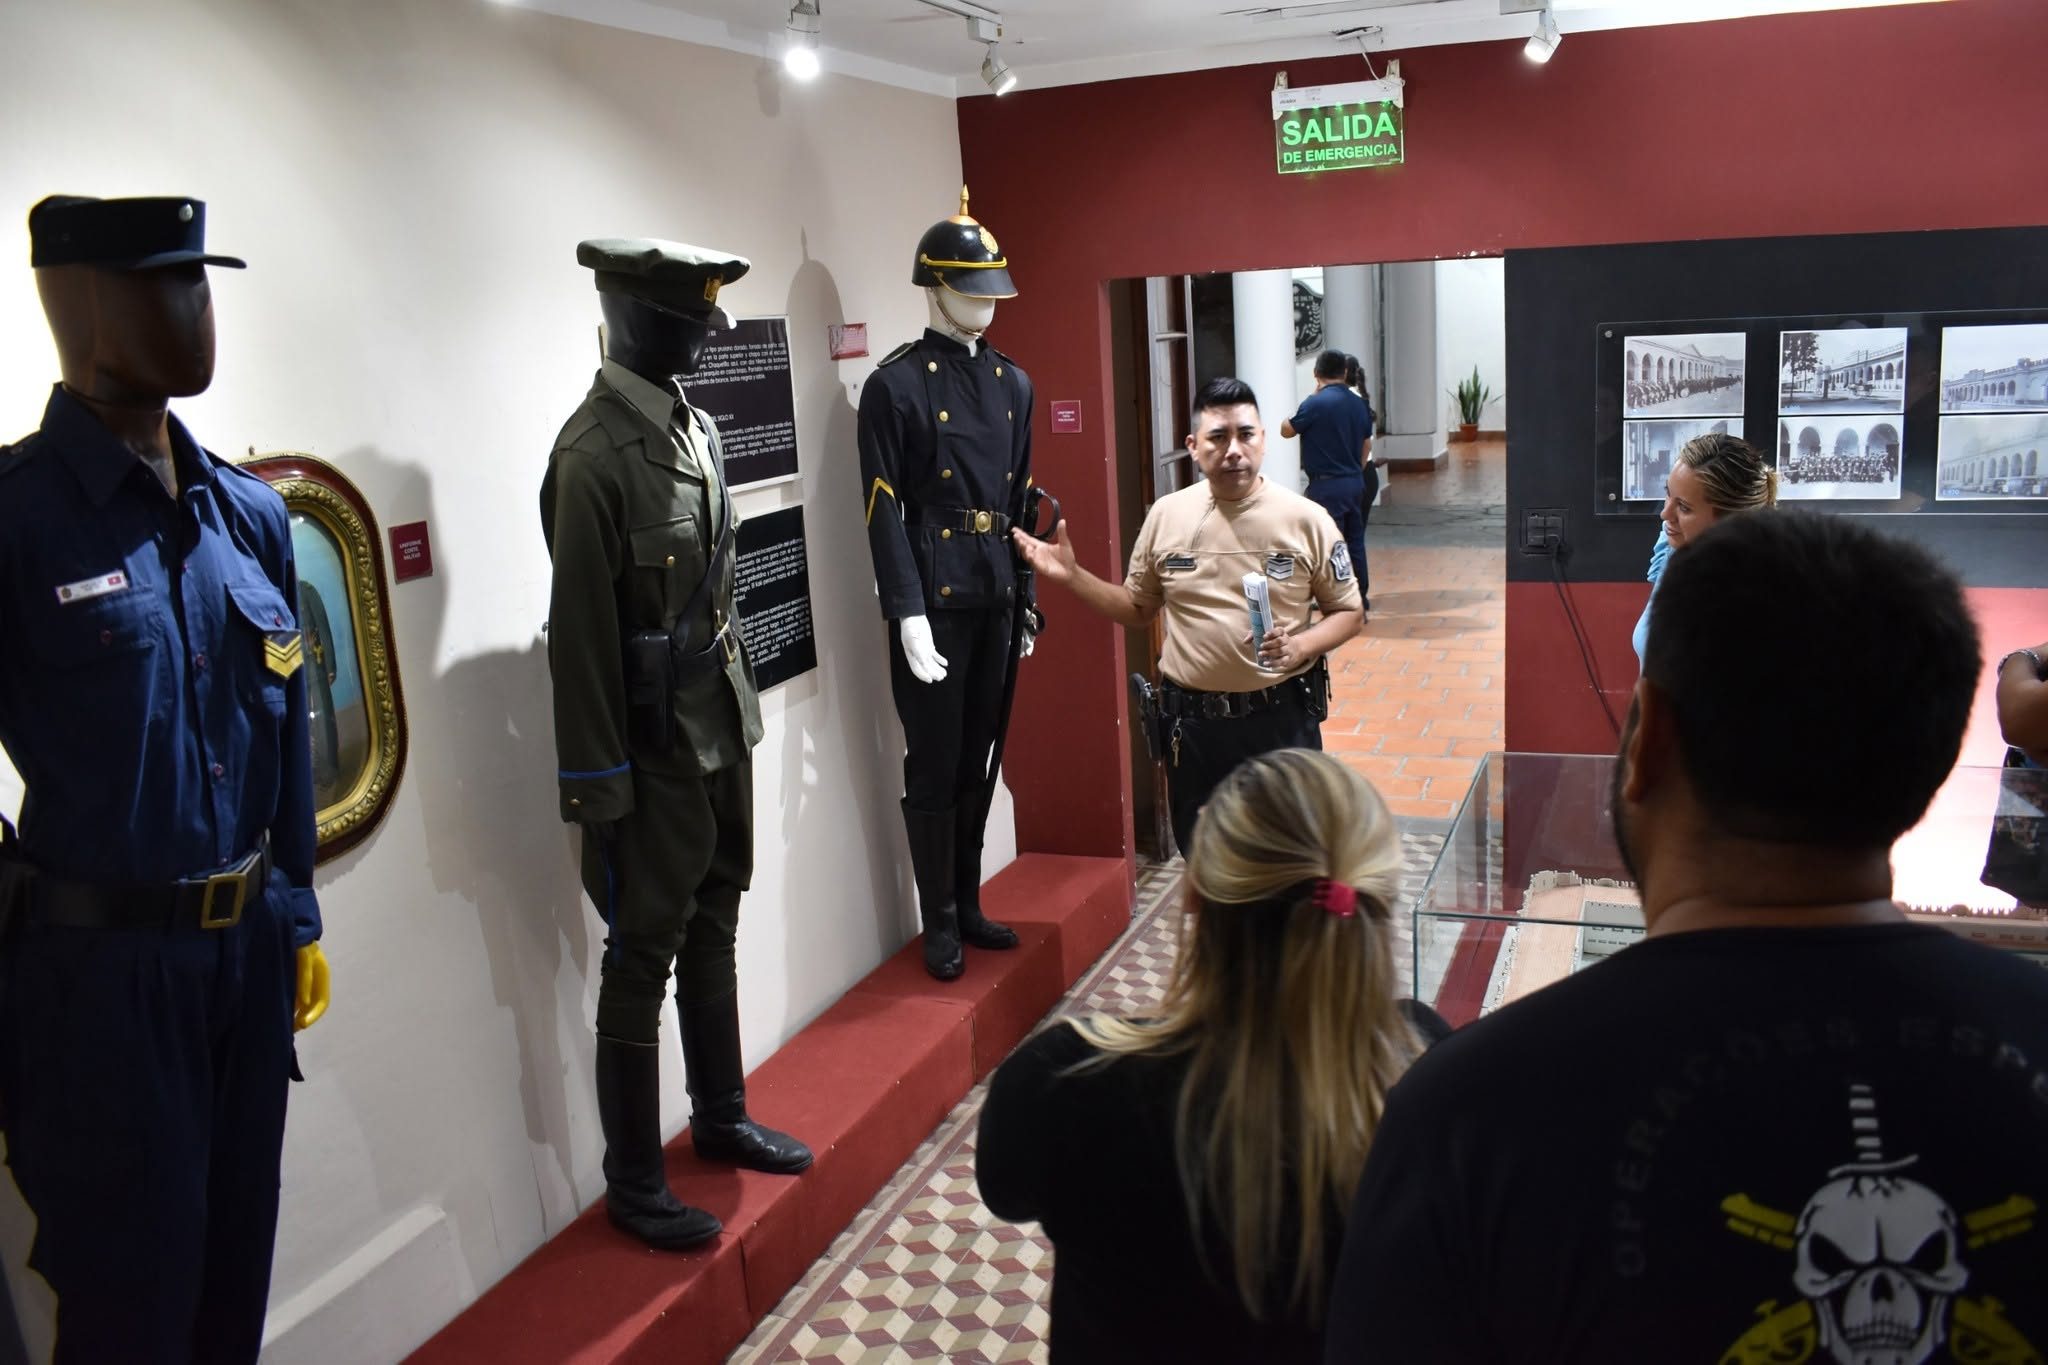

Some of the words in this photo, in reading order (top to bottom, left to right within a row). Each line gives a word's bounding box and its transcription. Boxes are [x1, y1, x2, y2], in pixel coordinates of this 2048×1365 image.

[1283, 112, 1396, 145] SALIDA
[1284, 151, 1302, 164] DE
[1306, 144, 1397, 162] EMERGENCIA
